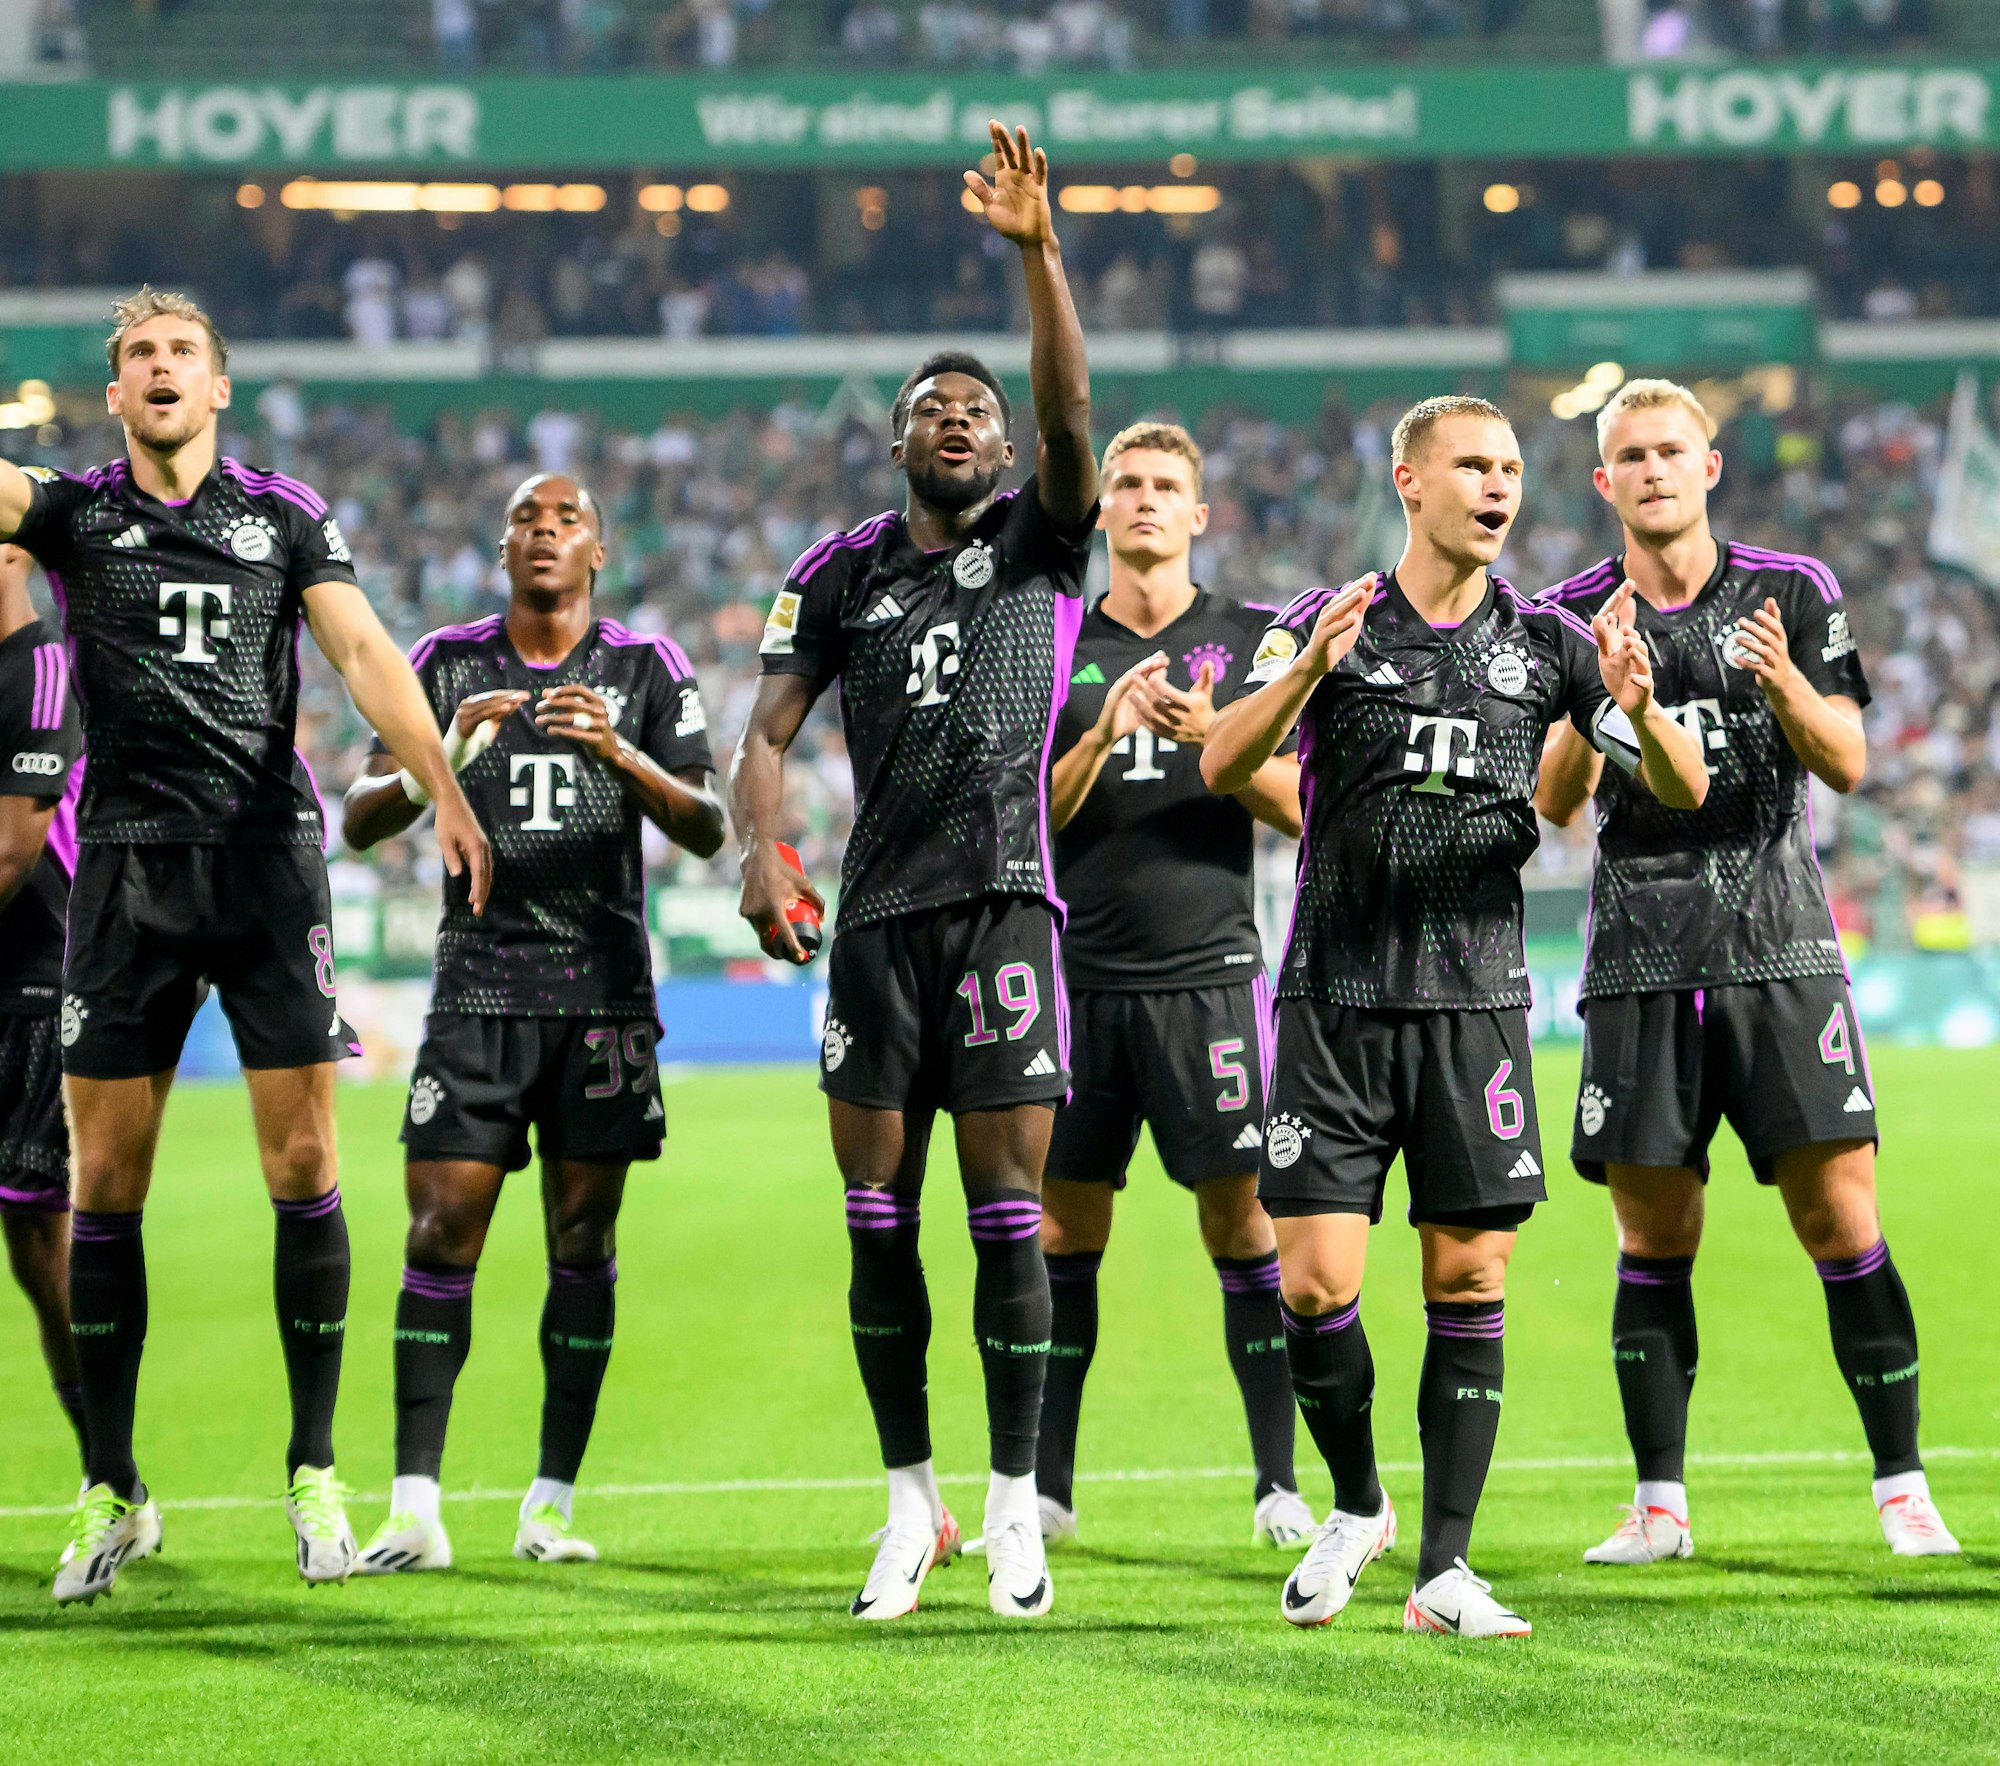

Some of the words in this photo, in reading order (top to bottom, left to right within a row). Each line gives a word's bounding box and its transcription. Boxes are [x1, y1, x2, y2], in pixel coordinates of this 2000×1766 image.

[109, 87, 479, 160] HOYER
[698, 95, 804, 147] Wir
[1629, 70, 1989, 145] HOYER
[158, 582, 232, 663] T
[509, 754, 577, 831] T
[1403, 713, 1478, 797] T
[307, 923, 336, 999] 8
[956, 961, 1040, 1048] 19
[1817, 1001, 1856, 1076] 4
[584, 1022, 657, 1100] 39
[1208, 1037, 1251, 1114] 5
[1484, 1058, 1525, 1142] 6
[1457, 1388, 1480, 1400] FC
